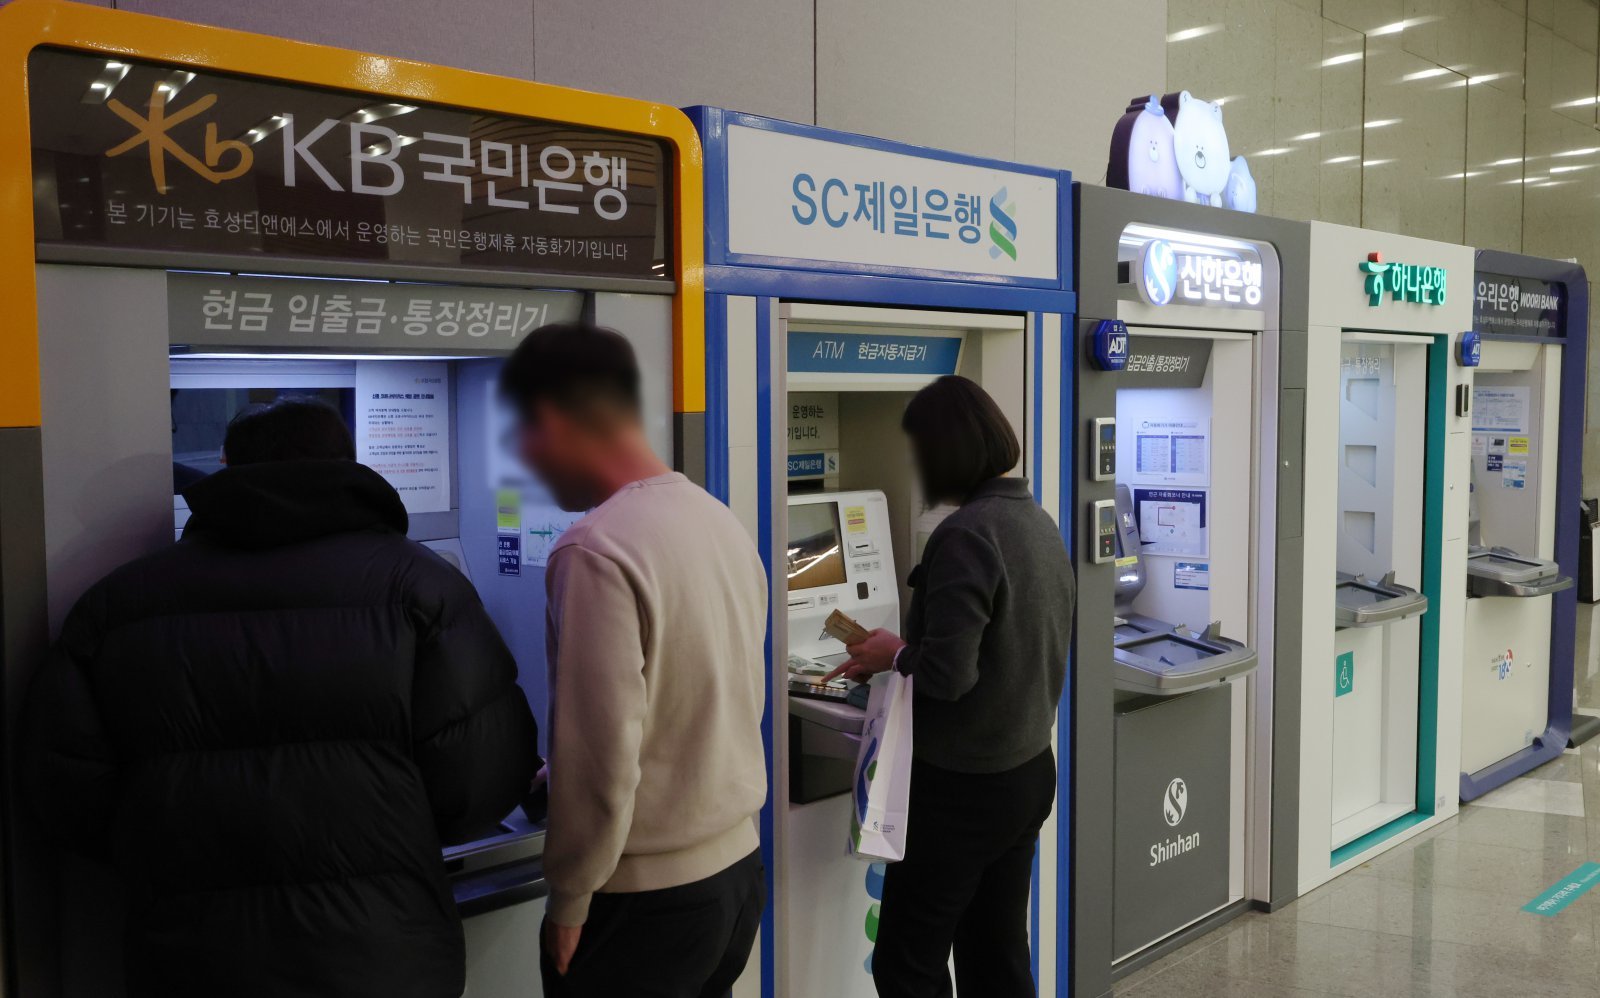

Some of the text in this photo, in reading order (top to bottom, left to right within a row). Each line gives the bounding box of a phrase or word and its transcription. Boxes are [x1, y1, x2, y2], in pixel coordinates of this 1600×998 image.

[791, 173, 981, 244] SC제일은행
[107, 201, 628, 261] 본 기기는 효성티앤에스에서 운영하는 국민은행제휴 자동화기기입니다
[1180, 255, 1263, 305] 신한은행
[1391, 262, 1447, 306] 하나은행
[1476, 281, 1559, 313] 우리은행 WOORI BANK
[201, 289, 274, 332] 현금
[812, 341, 928, 361] ATM 현금자동지급기
[1109, 337, 1126, 354] ADT
[792, 404, 824, 419] 운영하는
[1149, 831, 1200, 867] Shinhan
